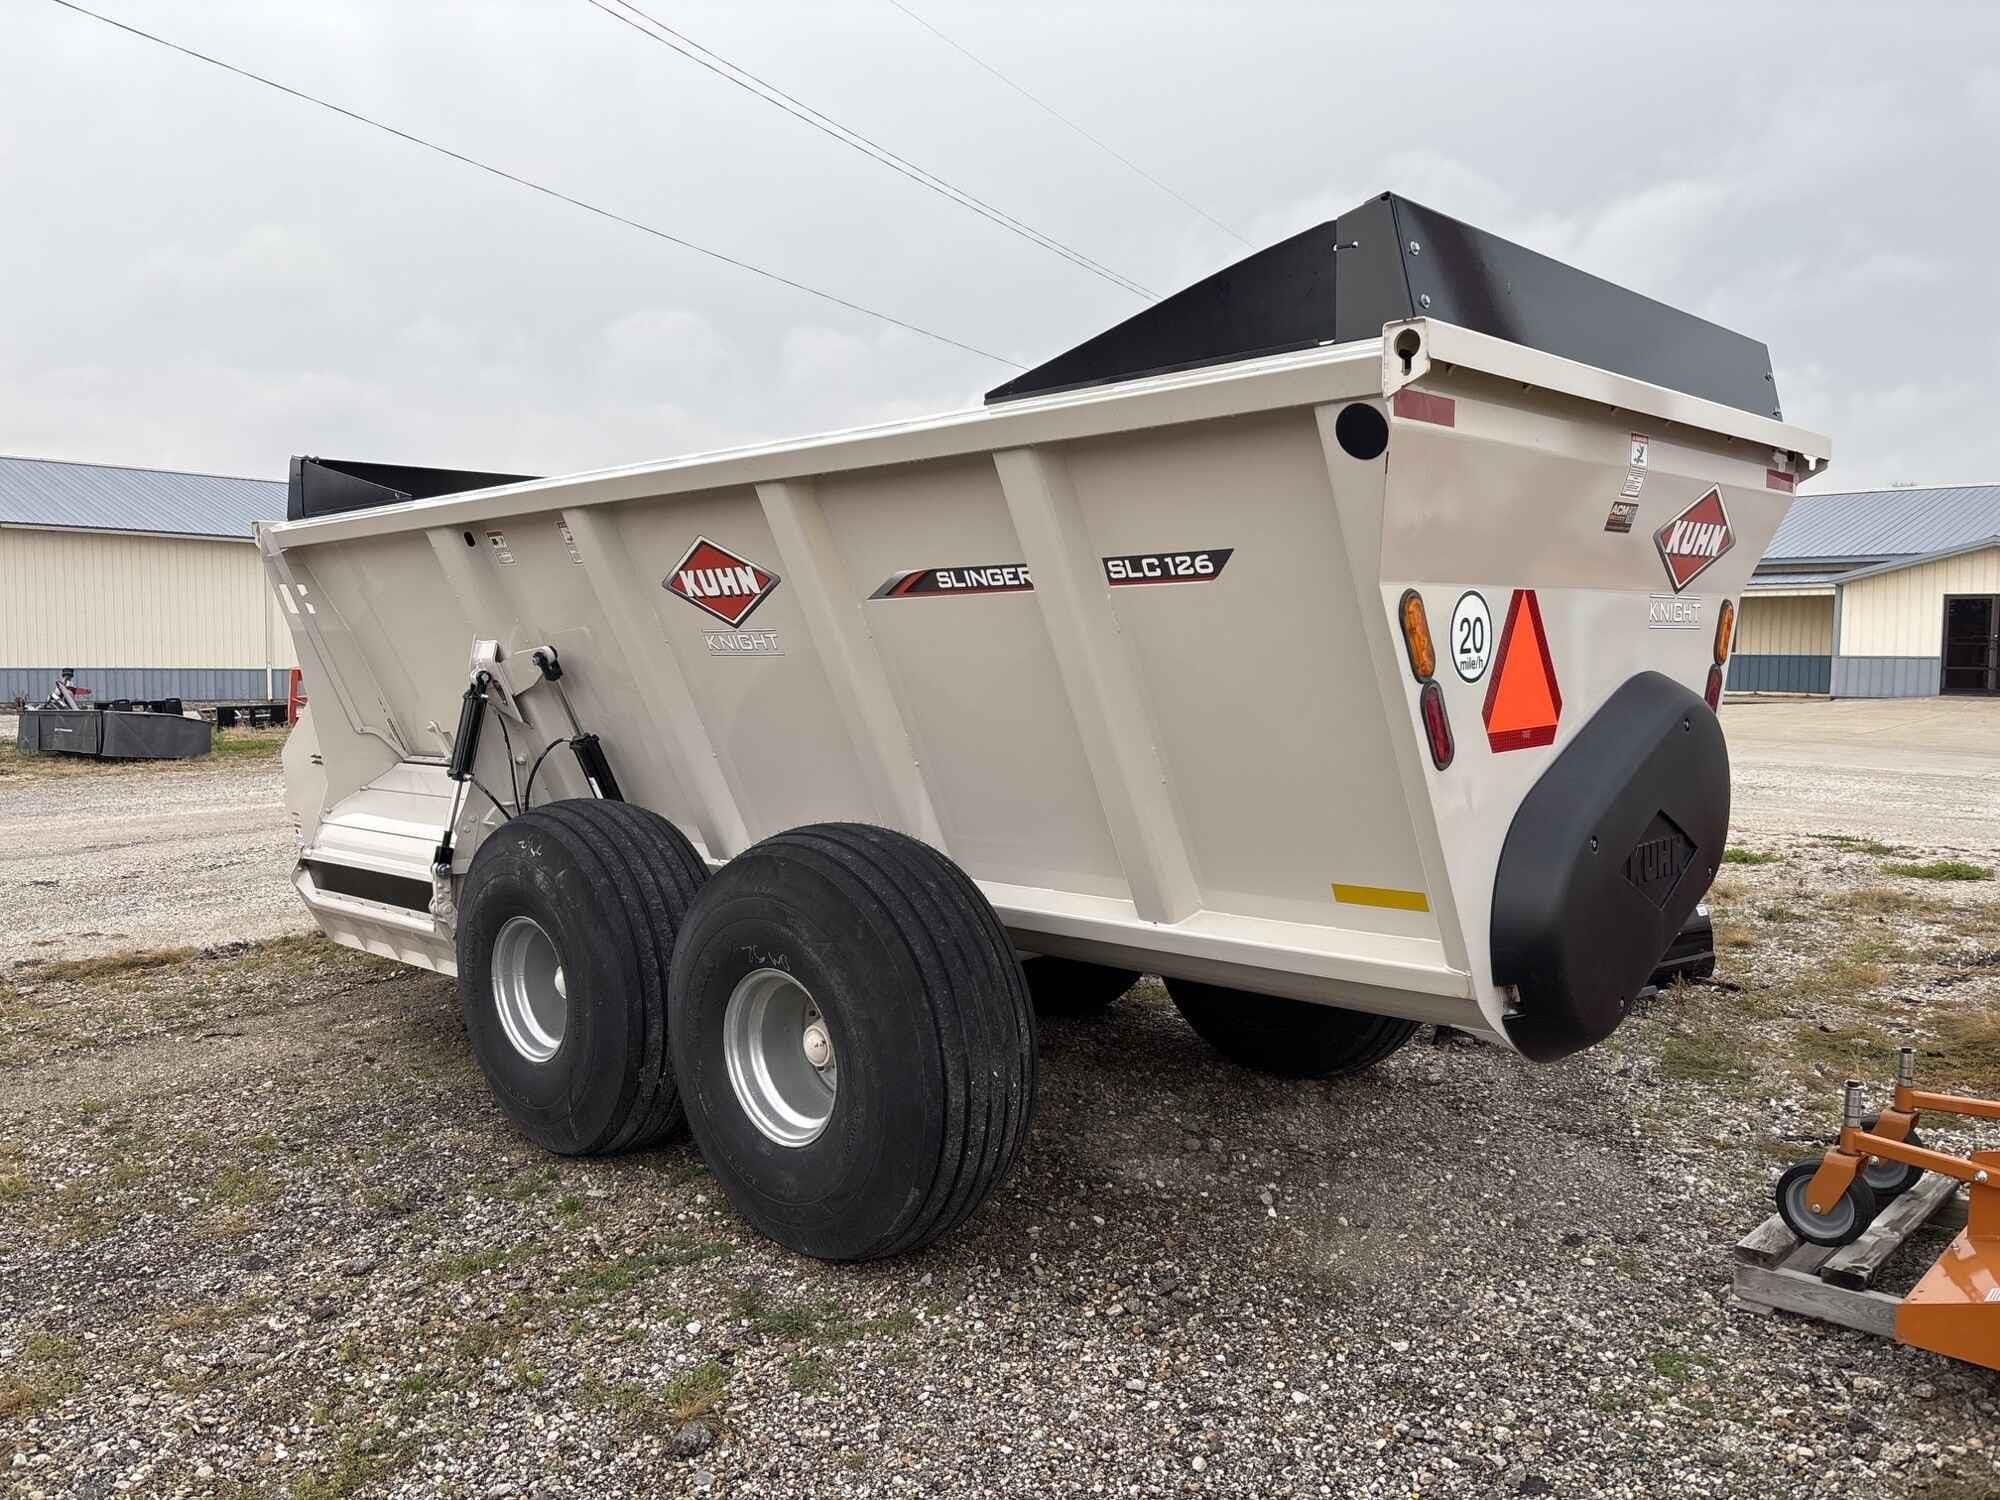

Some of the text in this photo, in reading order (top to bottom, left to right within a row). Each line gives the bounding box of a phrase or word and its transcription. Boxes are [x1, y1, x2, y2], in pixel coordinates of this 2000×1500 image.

[1665, 519, 1727, 557] KUHN
[1107, 554, 1215, 578] SLC 126
[679, 566, 761, 597] KUHN
[936, 567, 1033, 588] SLINGER
[1649, 601, 1701, 622] KNIGHT
[704, 633, 778, 651] KNIGHT
[1460, 616, 1484, 654] 20
[1460, 656, 1483, 671] mile/h
